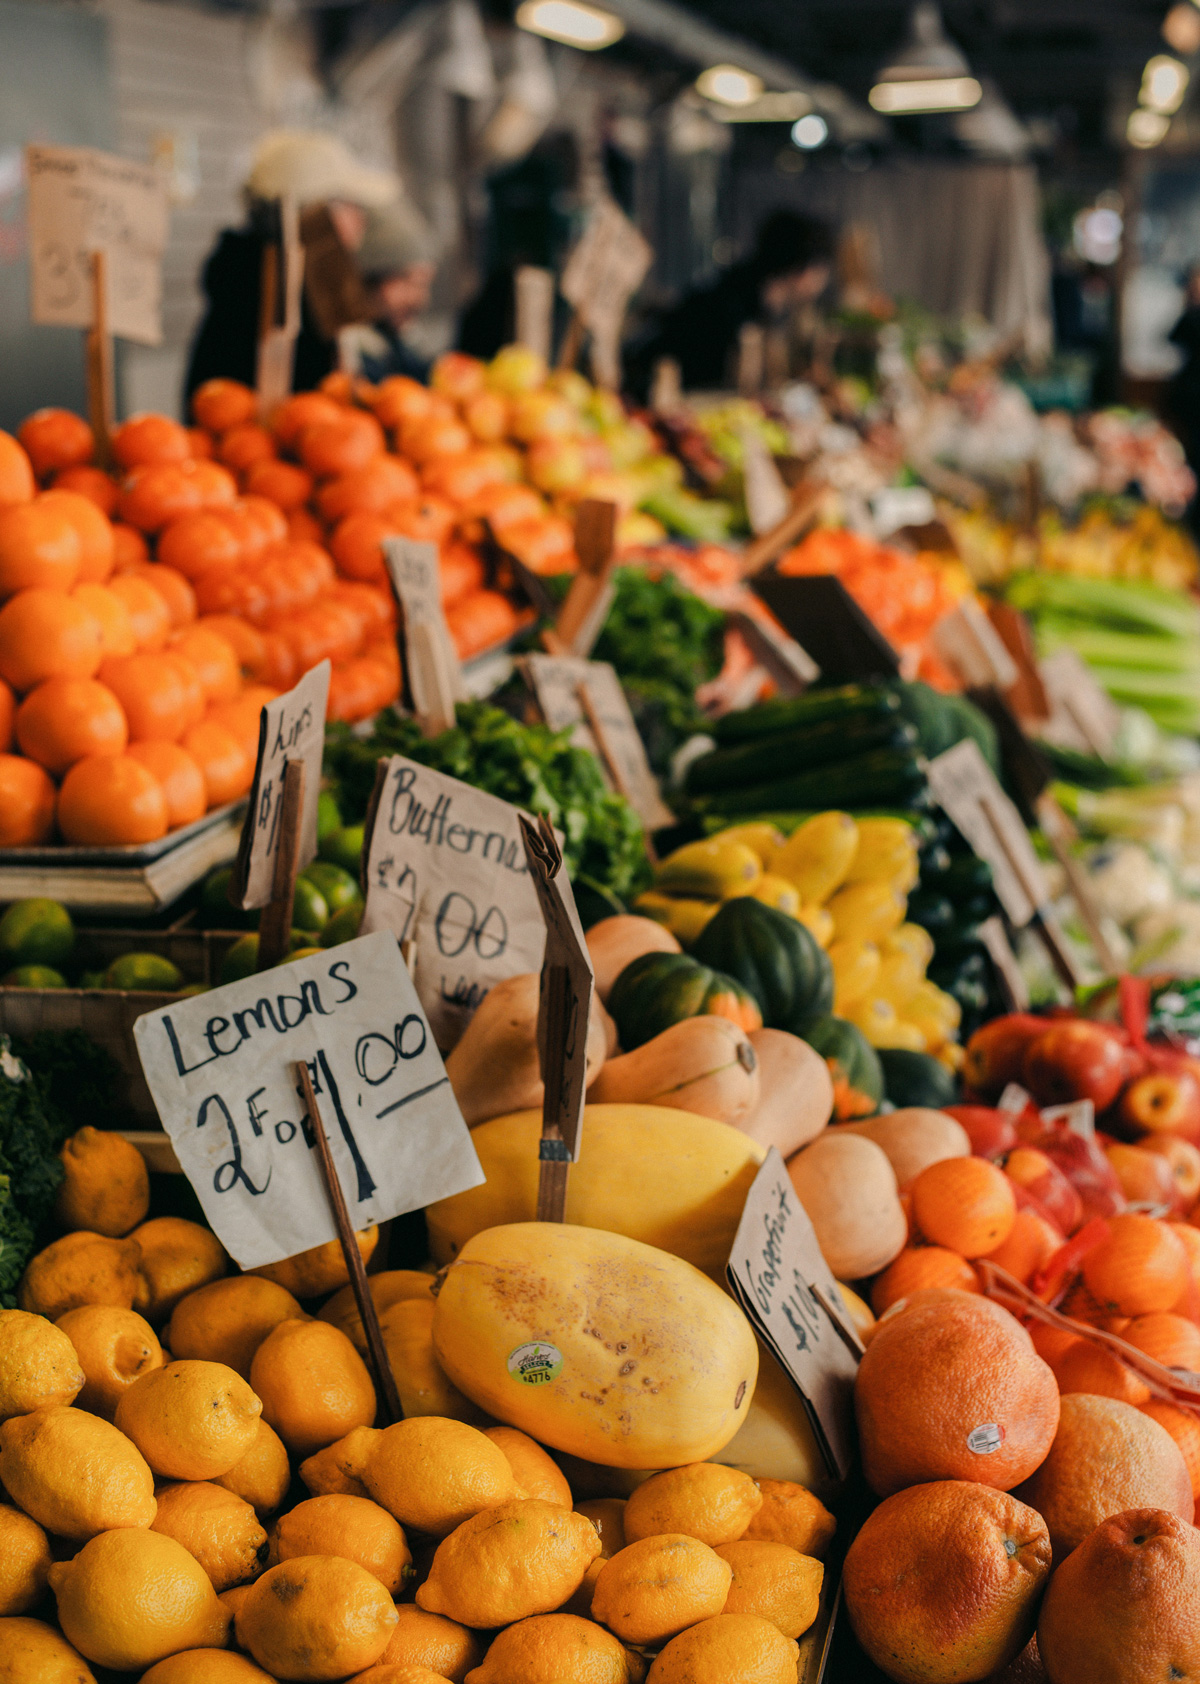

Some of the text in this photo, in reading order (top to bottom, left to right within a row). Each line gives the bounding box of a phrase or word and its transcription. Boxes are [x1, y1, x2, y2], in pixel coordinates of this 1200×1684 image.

[389, 767, 529, 876] Butternu
[161, 961, 358, 1077] Lemons
[196, 1093, 272, 1197] 2
